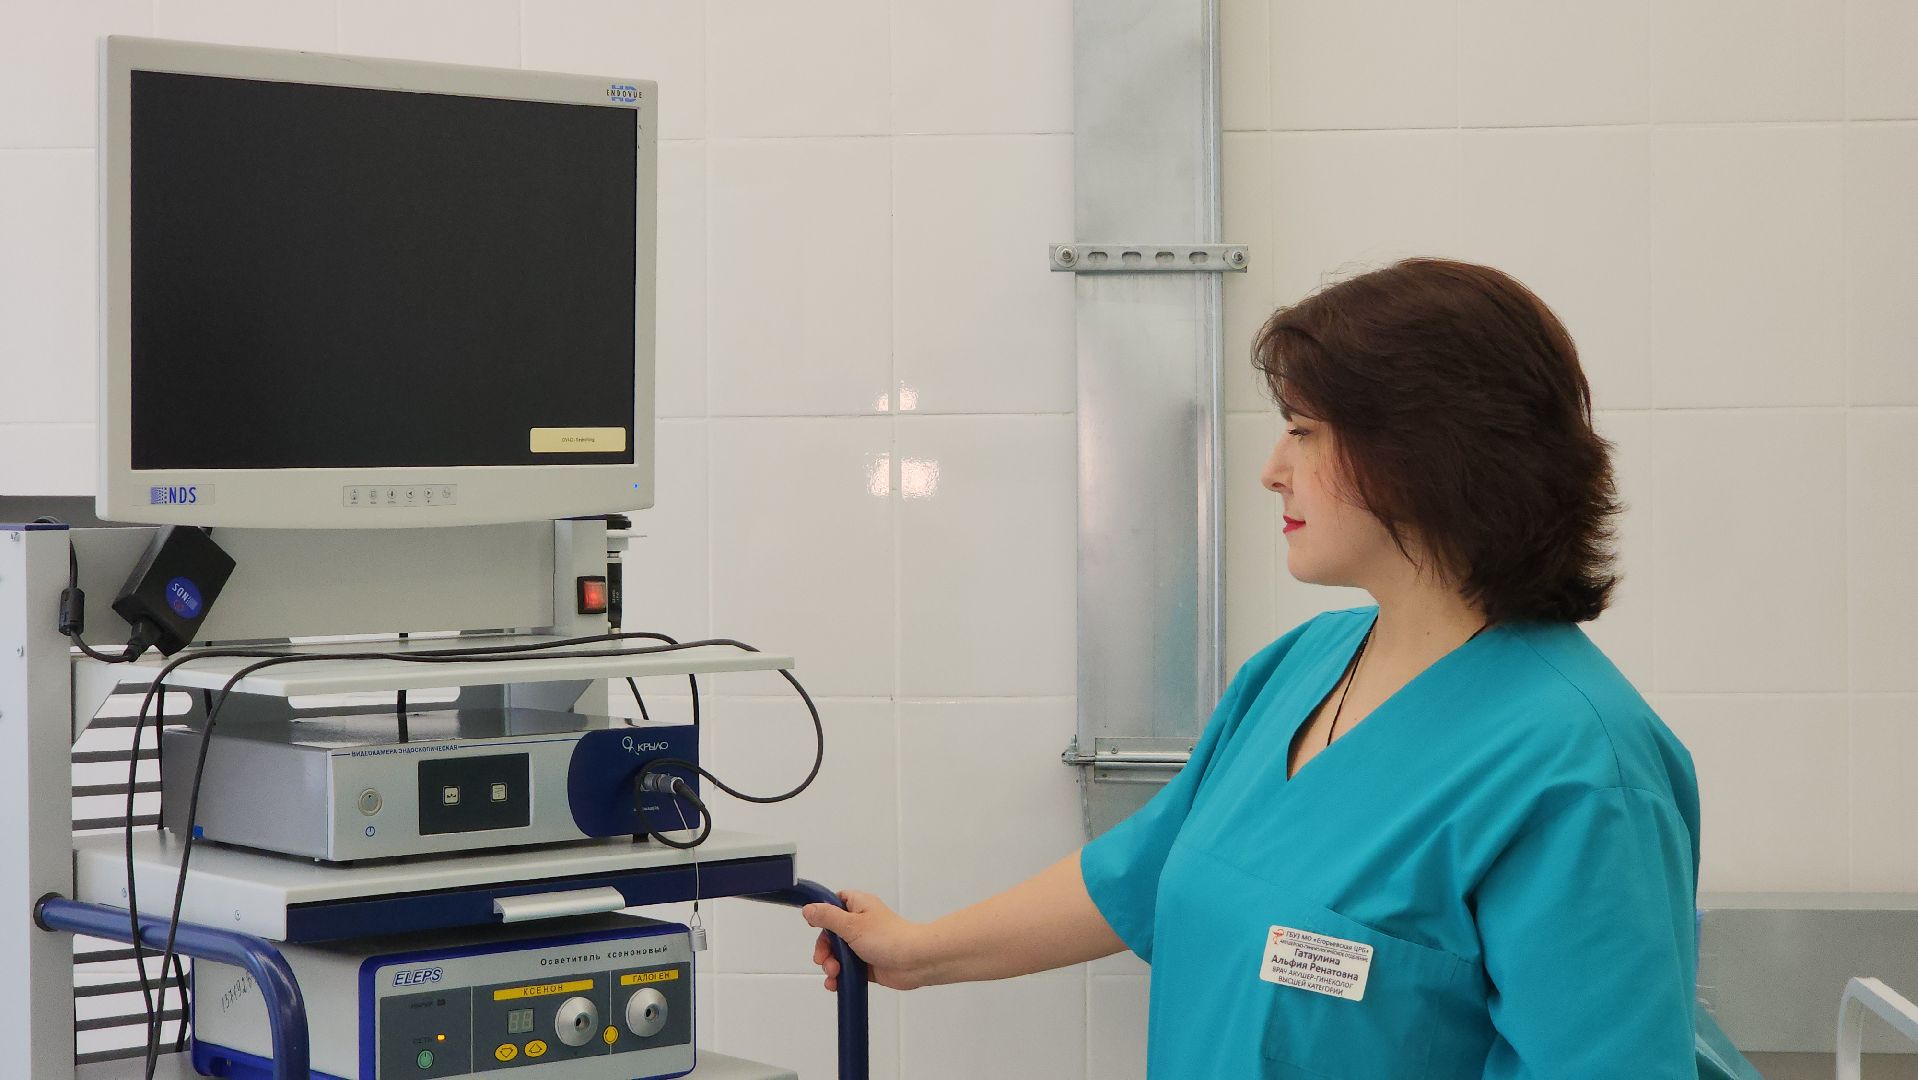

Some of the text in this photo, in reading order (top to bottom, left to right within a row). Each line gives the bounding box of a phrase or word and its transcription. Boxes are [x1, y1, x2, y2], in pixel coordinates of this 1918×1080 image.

[606, 89, 643, 98] ENDOVUE
[169, 487, 196, 503] NDS
[351, 744, 458, 757] ВИДЕОКАМЕРА ЭНДОСКОПИЧЕСКАЯ
[637, 742, 669, 752] КРЫЛО
[1302, 933, 1312, 941] МО
[540, 945, 668, 966] Осветитель ксеноновый
[1295, 948, 1340, 966] Гатаулина
[1272, 955, 1359, 981] Альфия Ренатовна
[1272, 966, 1287, 974] ВРАЧ
[393, 967, 443, 987] ELEPS
[632, 971, 670, 983] ГАЛОГЕН
[523, 985, 564, 996] КСЕНОН
[1278, 976, 1344, 995] ВЫСШЕЙ КАТЕГОРИИ
